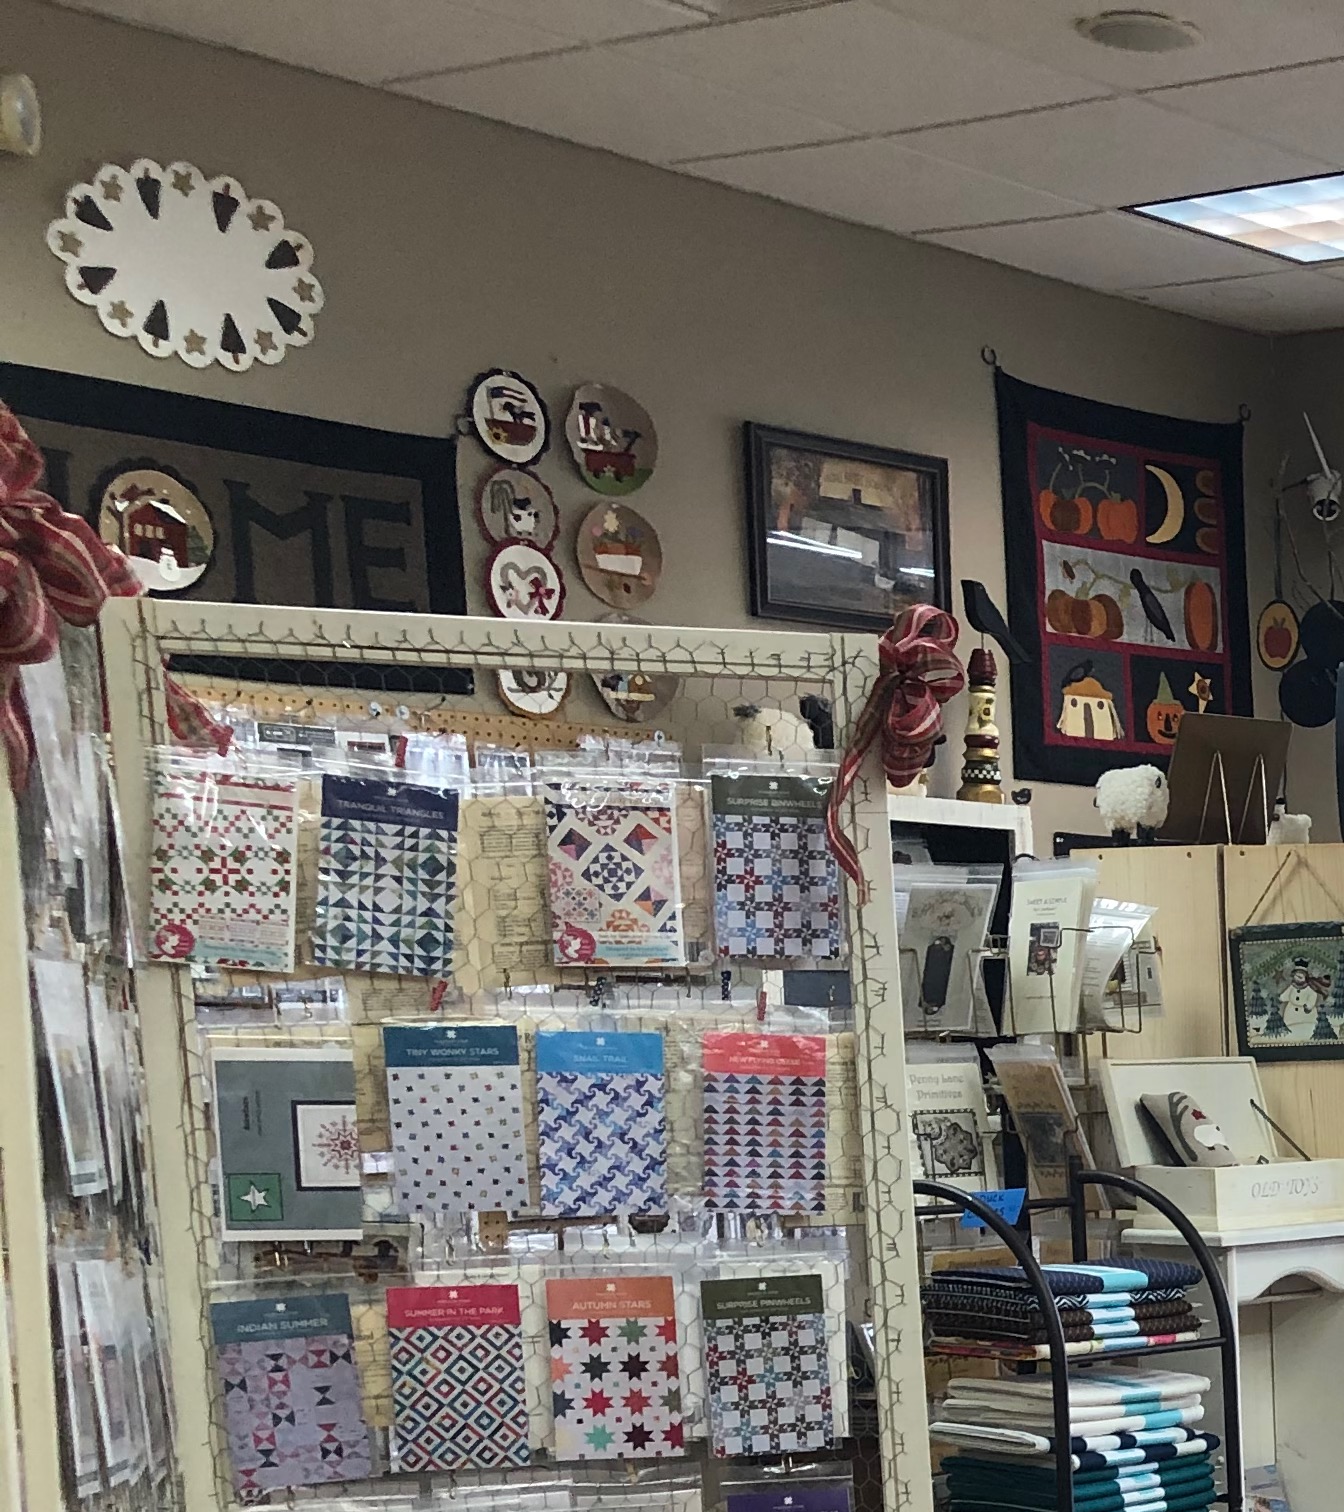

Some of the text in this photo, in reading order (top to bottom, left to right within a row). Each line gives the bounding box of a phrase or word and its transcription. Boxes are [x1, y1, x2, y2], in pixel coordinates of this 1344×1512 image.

[727, 797, 768, 806] SURPRISE
[337, 800, 445, 819] TRANQUIL TRIANGLES
[572, 1300, 652, 1310] AUTUMN STARS
[717, 1297, 811, 1310] SURPRISE PINWHEELS
[404, 1308, 444, 1317] SUMMER
[460, 1307, 477, 1315] THE
[237, 1318, 328, 1333] INDIAN SUMMER
